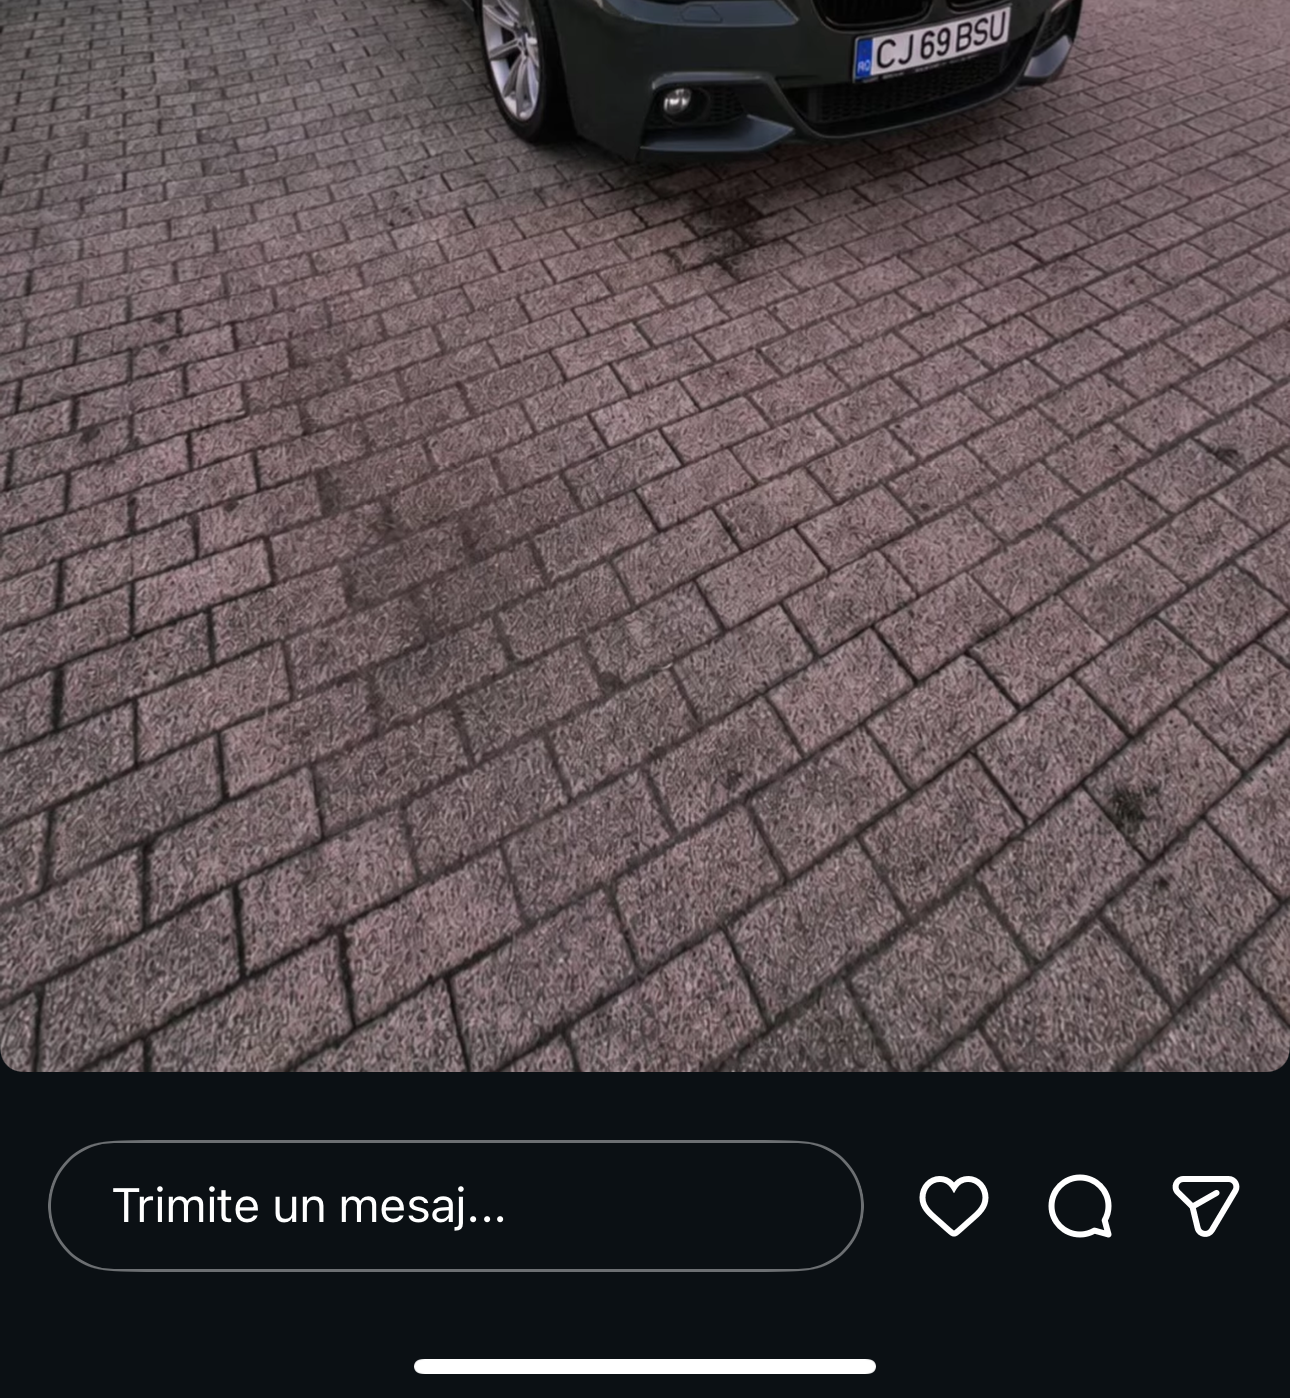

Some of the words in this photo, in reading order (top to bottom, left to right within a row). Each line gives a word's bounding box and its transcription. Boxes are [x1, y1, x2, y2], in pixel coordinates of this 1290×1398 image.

[876, 34, 914, 69] CJ
[920, 27, 951, 60] 69
[955, 11, 1006, 53] BSU
